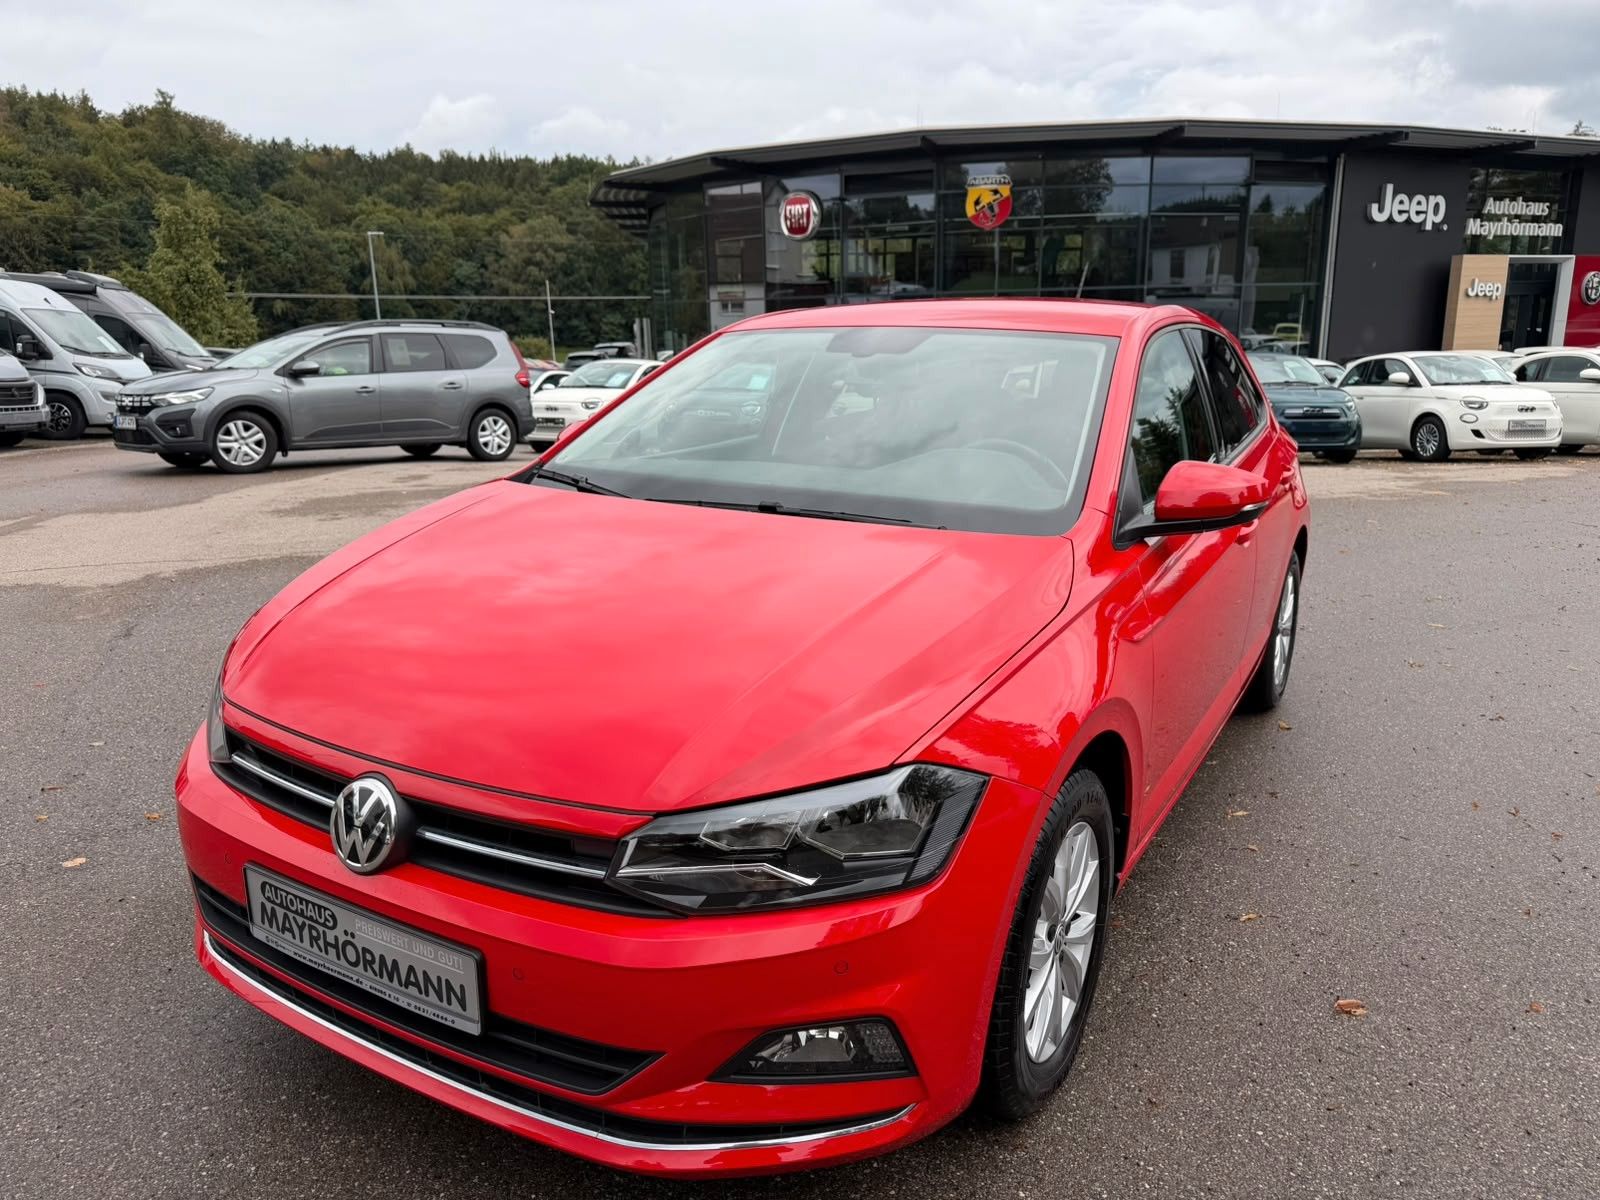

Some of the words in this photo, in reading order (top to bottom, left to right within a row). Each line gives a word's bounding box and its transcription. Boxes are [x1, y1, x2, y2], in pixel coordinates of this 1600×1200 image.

[785, 203, 810, 229] FIAT
[1370, 183, 1447, 231] Jeep
[1482, 196, 1551, 217] Autohaus
[1465, 217, 1564, 241] Mayrhörmann
[1467, 277, 1502, 301] Jeep
[264, 883, 335, 928] AUTOHAUS
[260, 901, 467, 1013] MAYRHÖRMANN
[412, 940, 434, 958] UND
